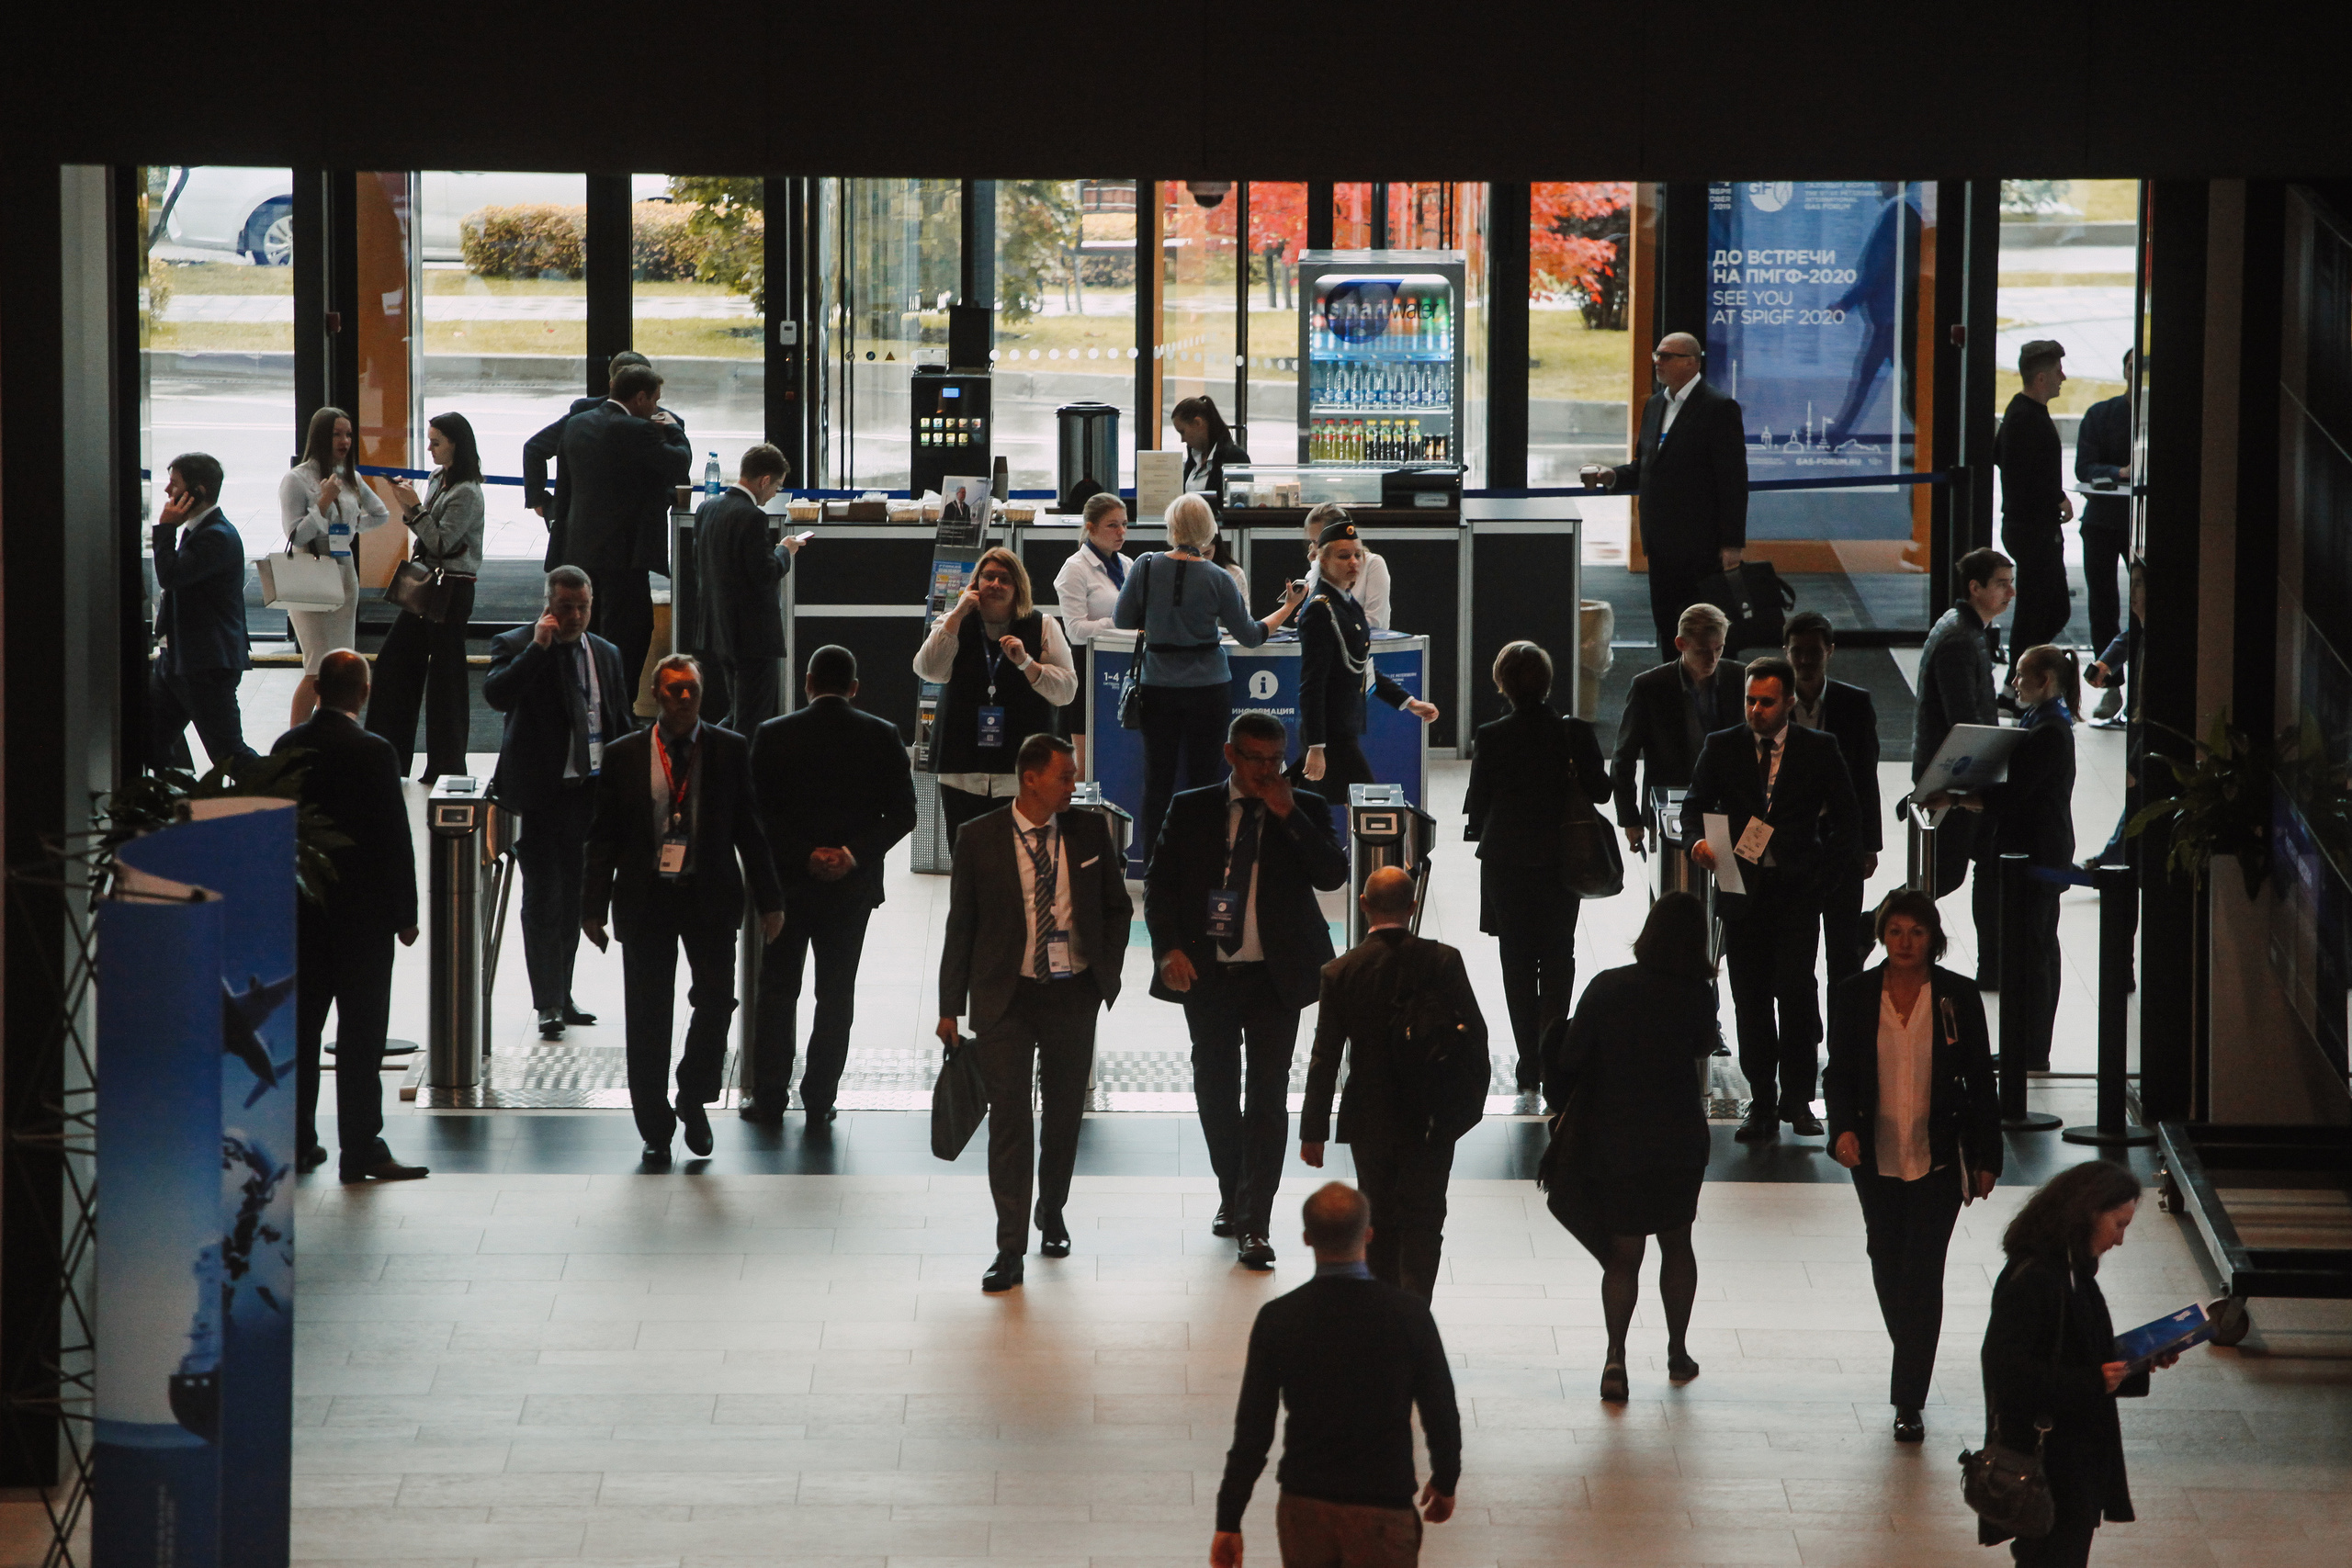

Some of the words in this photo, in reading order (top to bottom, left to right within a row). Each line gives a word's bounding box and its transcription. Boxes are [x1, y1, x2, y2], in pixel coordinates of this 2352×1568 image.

[1713, 250, 1743, 267] ДО
[1747, 250, 1836, 265] ВСТРЕЧИ
[1713, 268, 1741, 284] НА
[1747, 268, 1858, 284] ПМГФ-2020
[1713, 290, 1747, 306] SEE
[1753, 290, 1793, 306] YOU
[1713, 310, 1736, 324] AT
[1741, 310, 1794, 325] SPIGF
[1799, 310, 1846, 325] 2020
